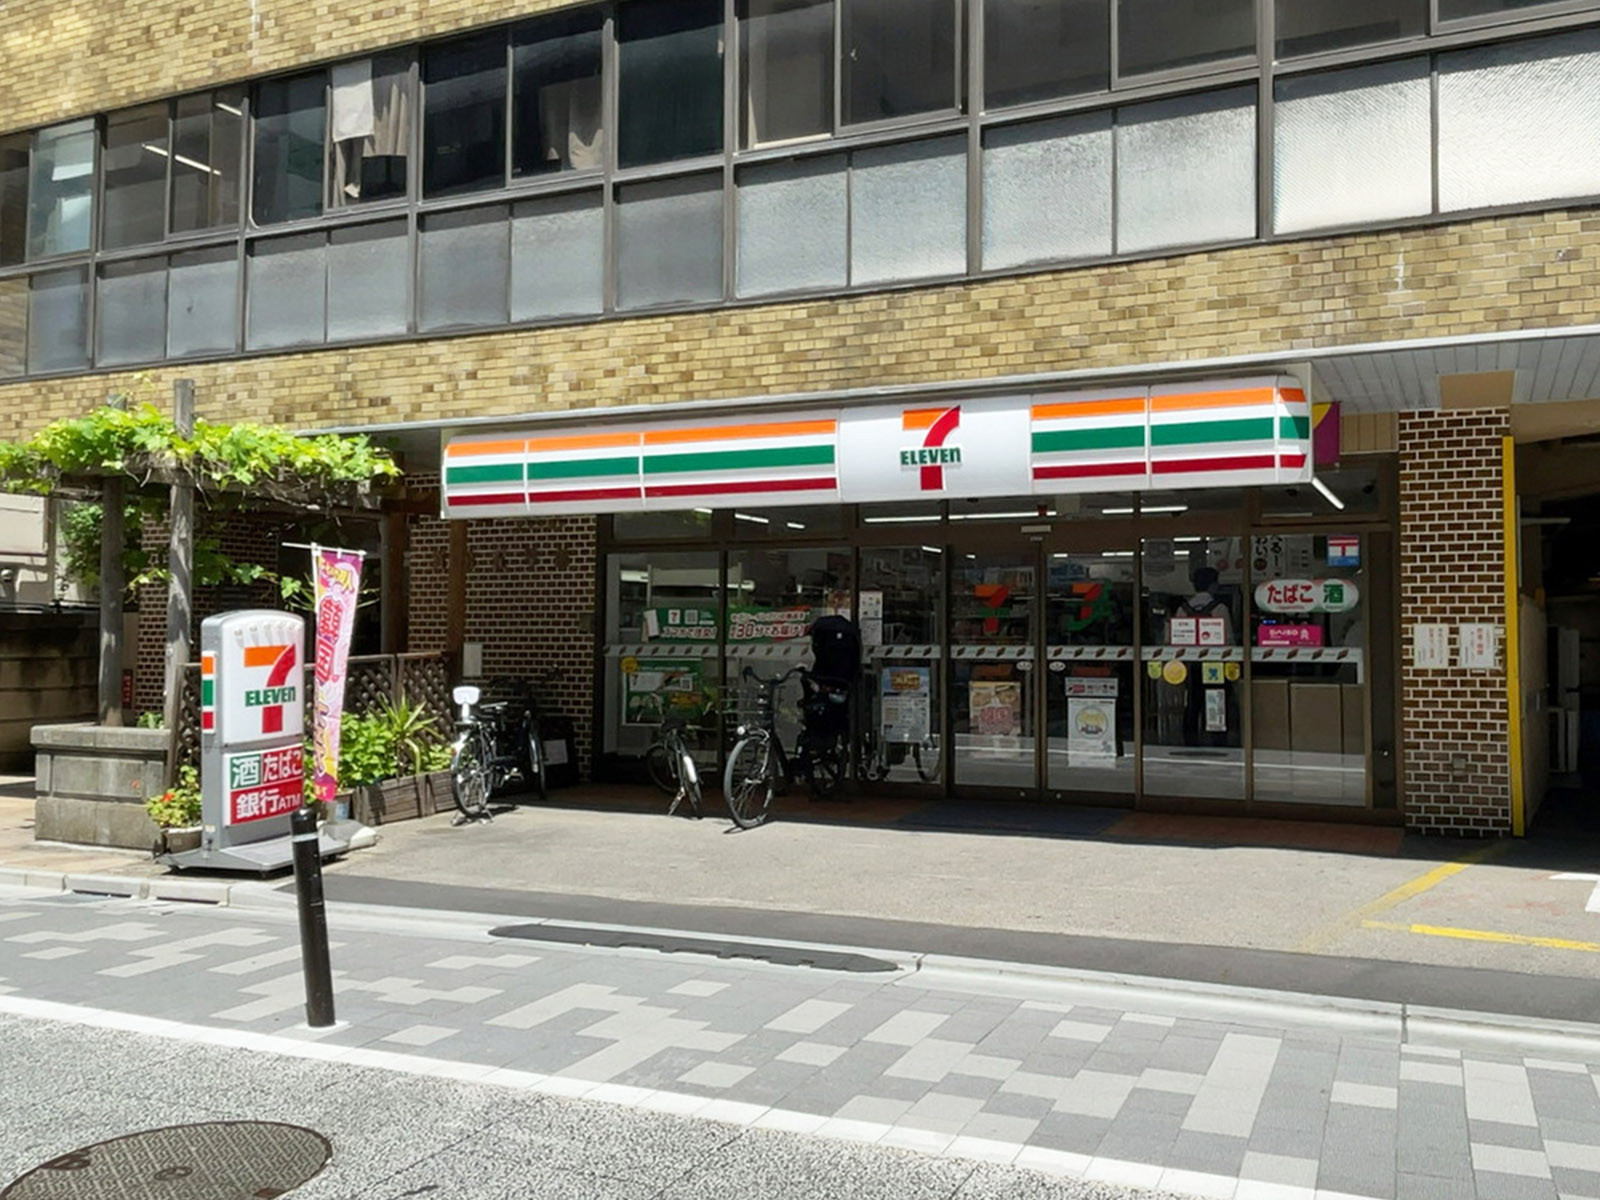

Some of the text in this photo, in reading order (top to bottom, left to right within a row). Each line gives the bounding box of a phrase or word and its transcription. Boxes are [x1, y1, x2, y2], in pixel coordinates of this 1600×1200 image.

[902, 405, 960, 490] 7
[1267, 584, 1344, 604] たばこ 酒
[244, 644, 296, 733] 7
[232, 749, 302, 788] 酒 たばこ
[236, 788, 301, 819] 銀行ATM
